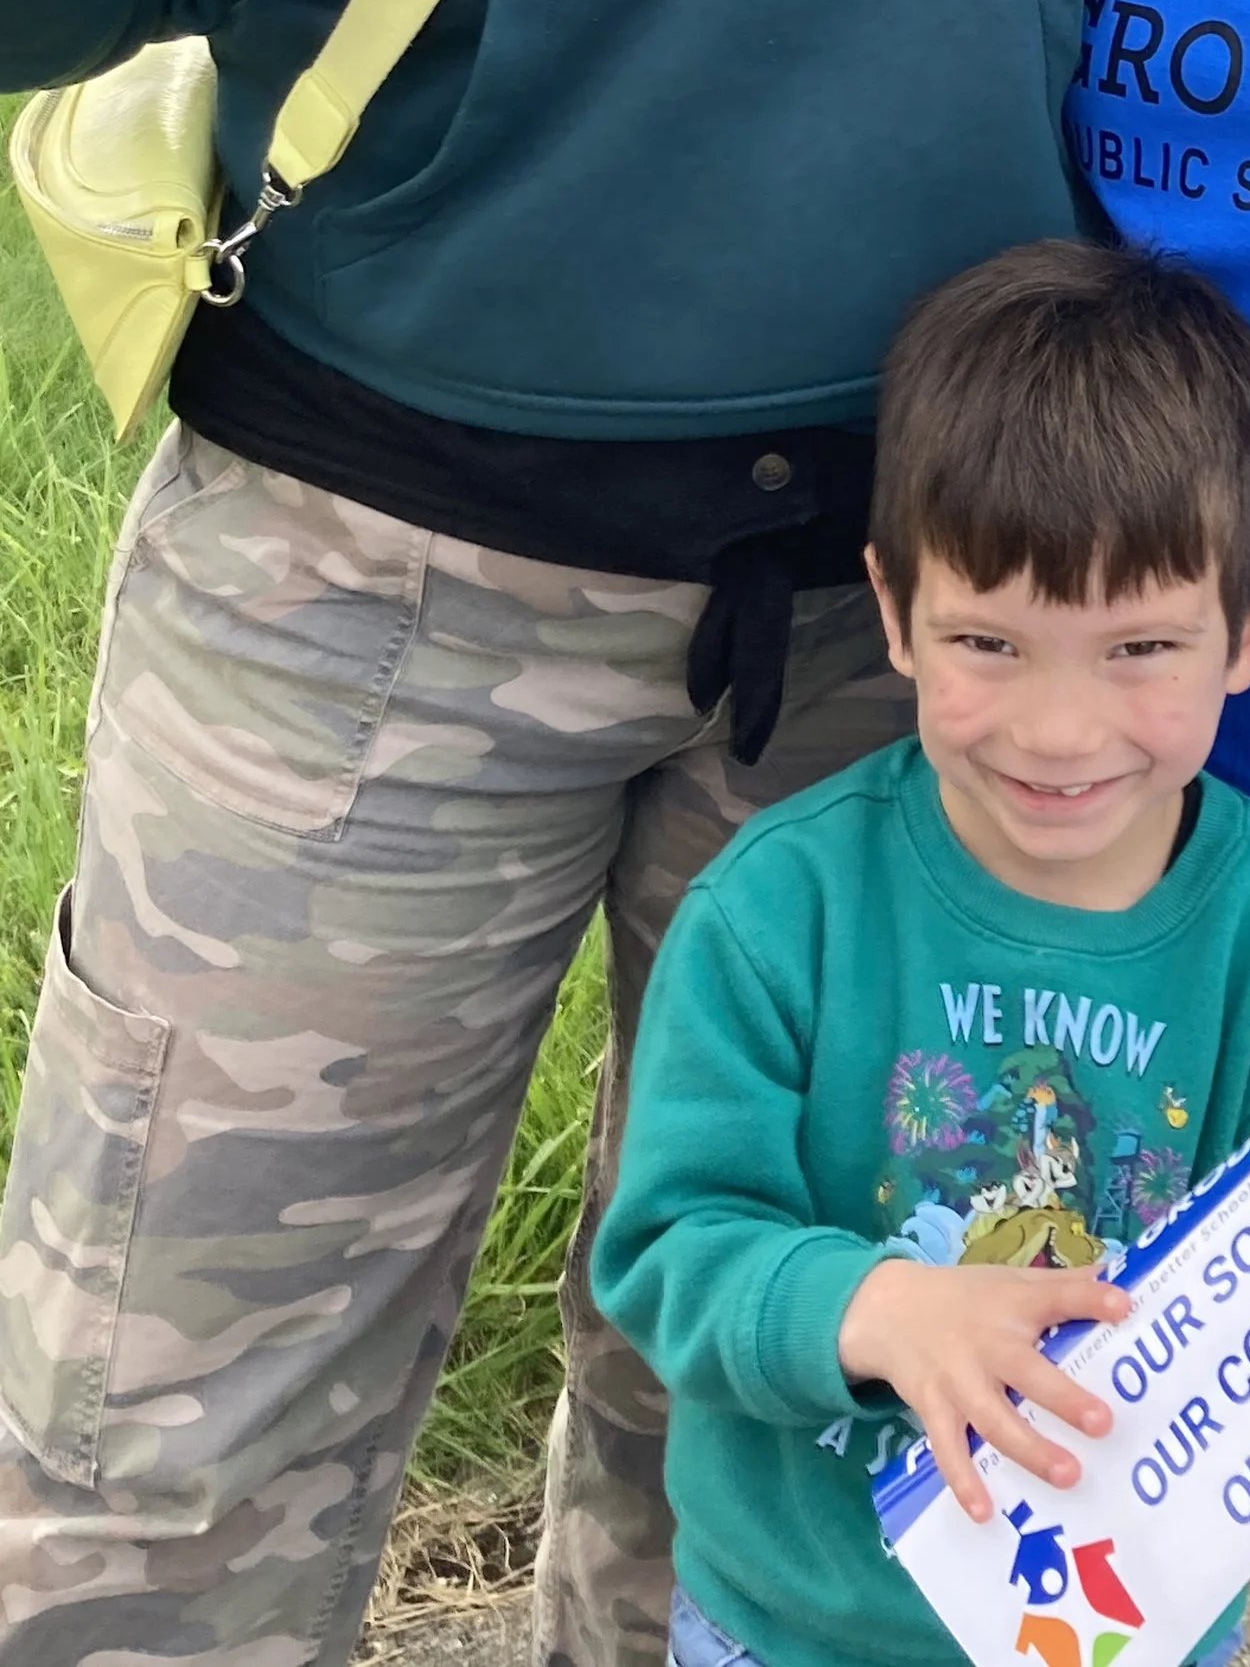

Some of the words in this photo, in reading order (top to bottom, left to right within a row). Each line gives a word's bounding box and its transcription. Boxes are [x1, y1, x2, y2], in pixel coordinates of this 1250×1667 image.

[938, 982, 1003, 1047] WE
[1024, 986, 1168, 1077] KNOW
[1149, 1243, 1198, 1294] better
[1110, 1294, 1206, 1404] OUR
[1130, 1396, 1226, 1507] OUR
